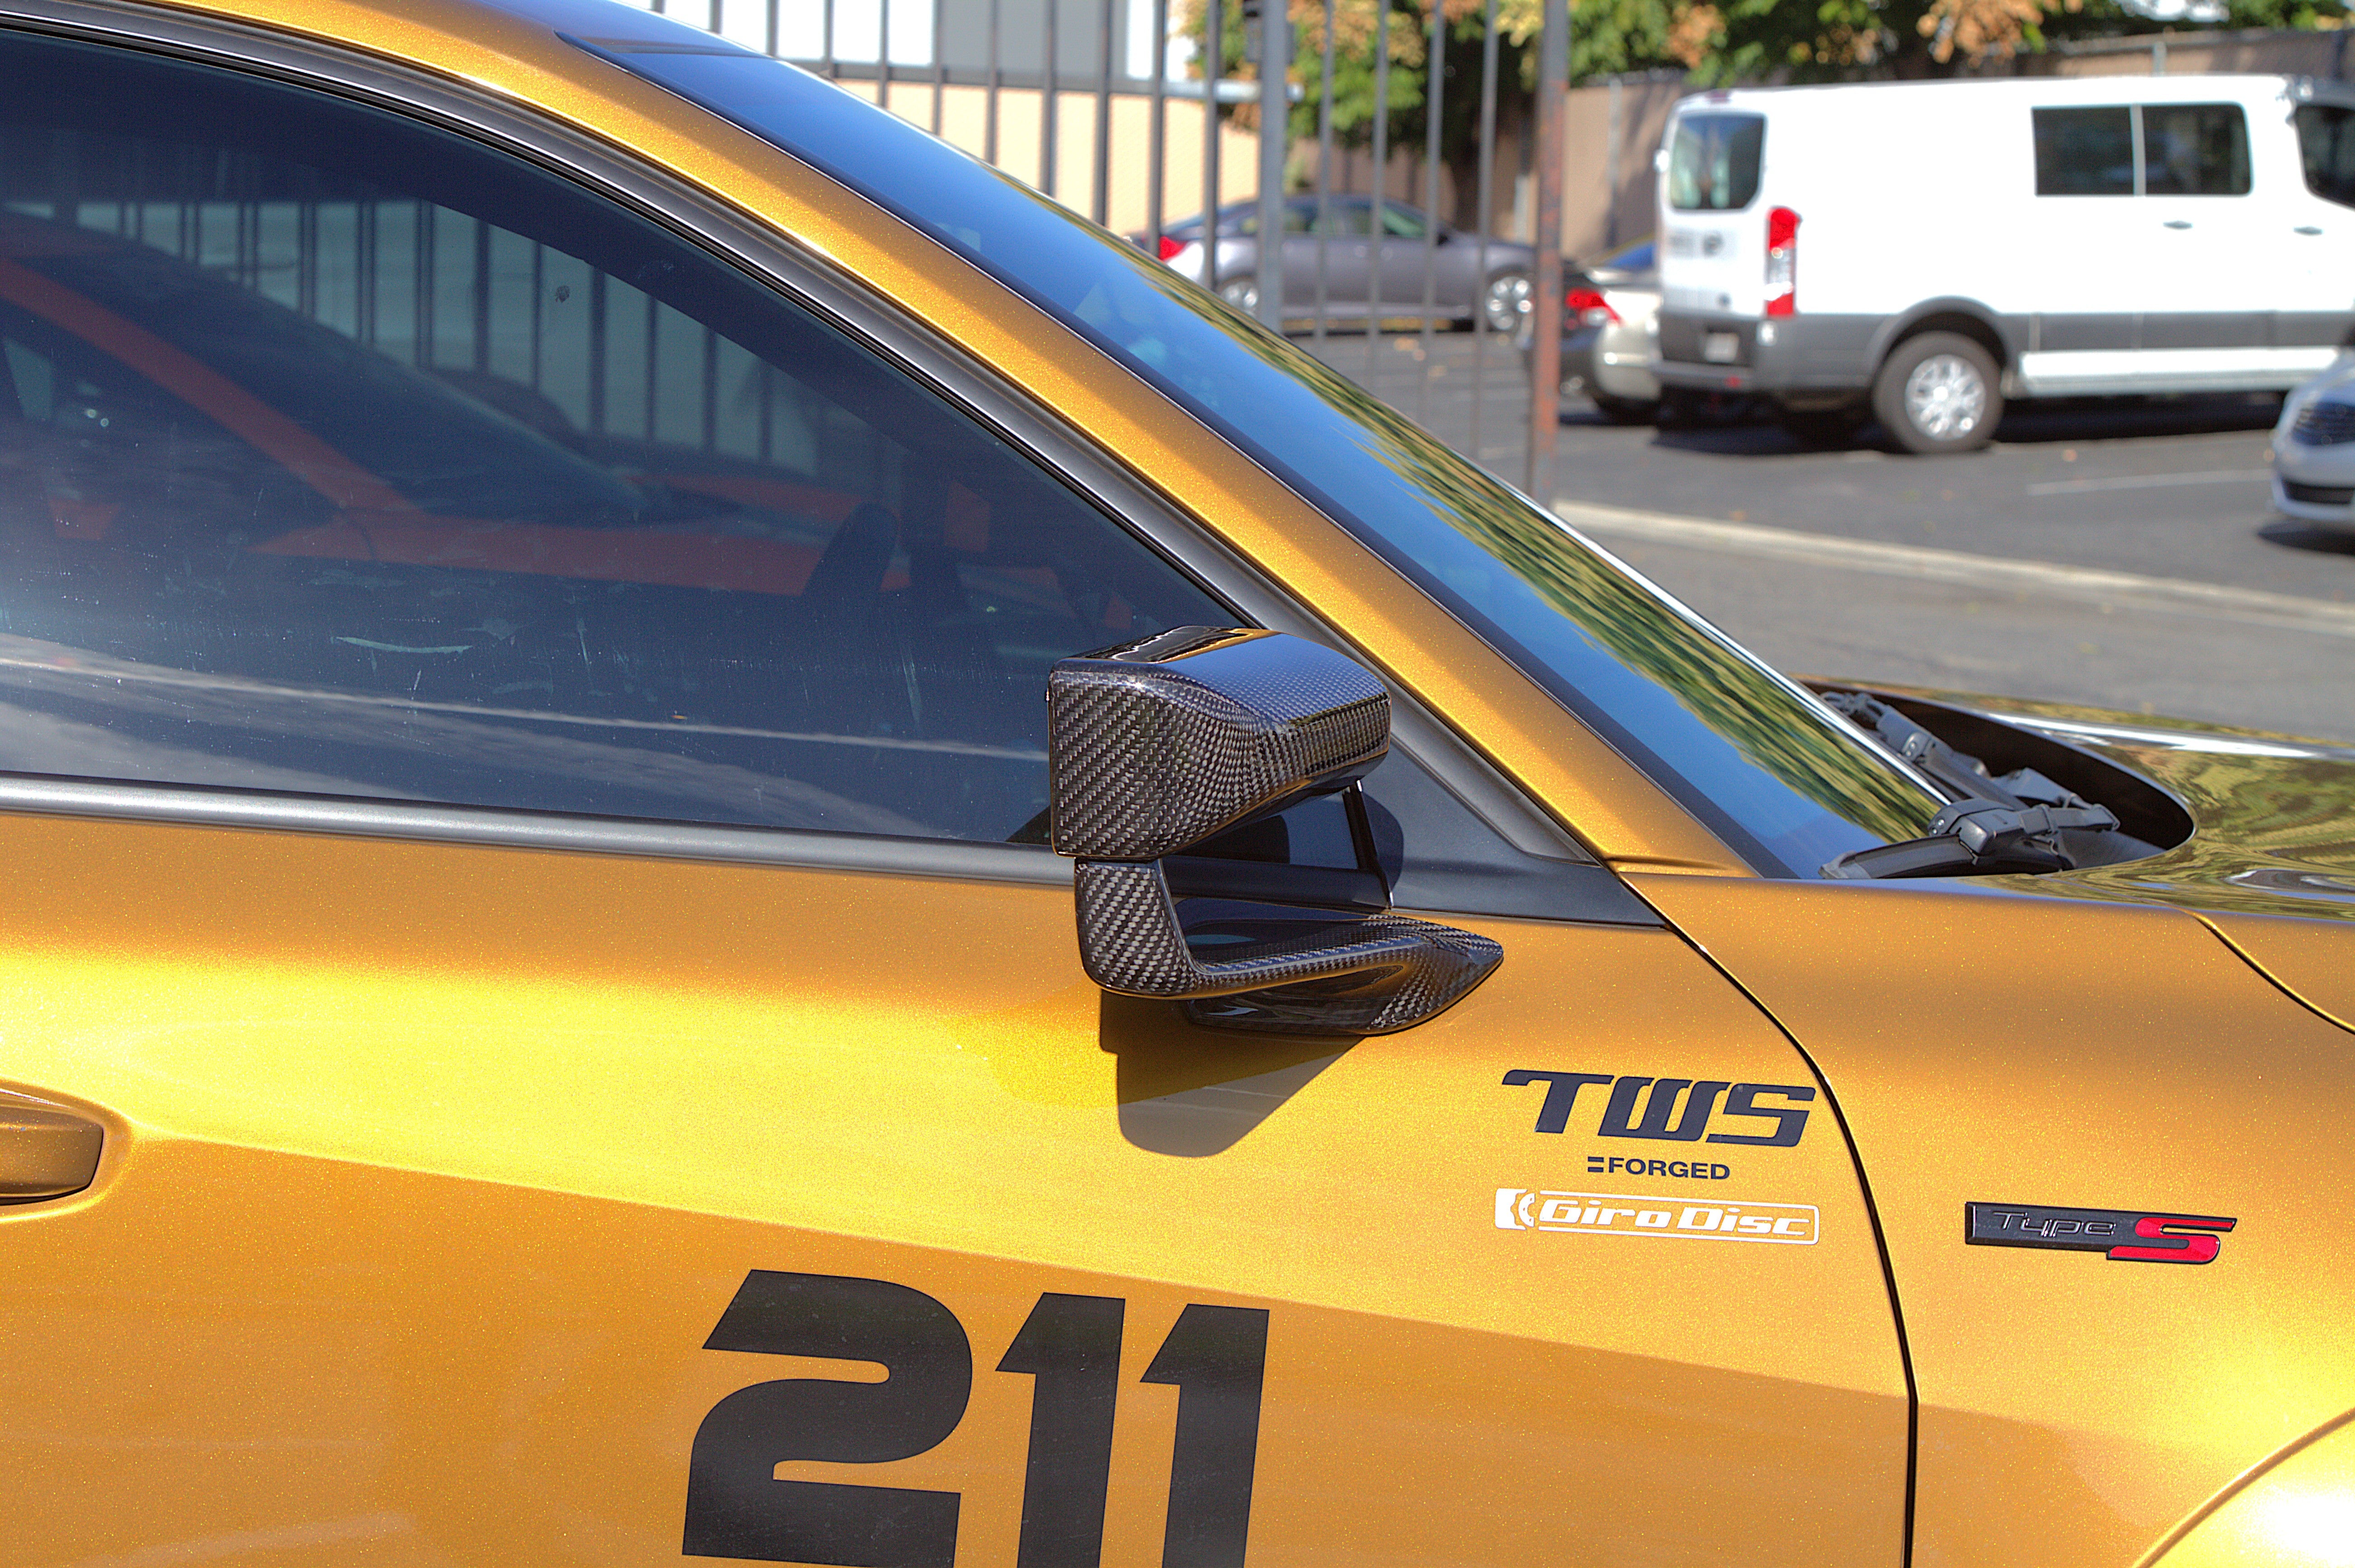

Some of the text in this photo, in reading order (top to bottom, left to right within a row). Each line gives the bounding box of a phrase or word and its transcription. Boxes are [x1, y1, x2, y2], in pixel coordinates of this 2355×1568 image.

[1502, 1070, 1816, 1147] TWS
[1993, 1212, 2236, 1263] Type S
[682, 1269, 1269, 1568] 211
